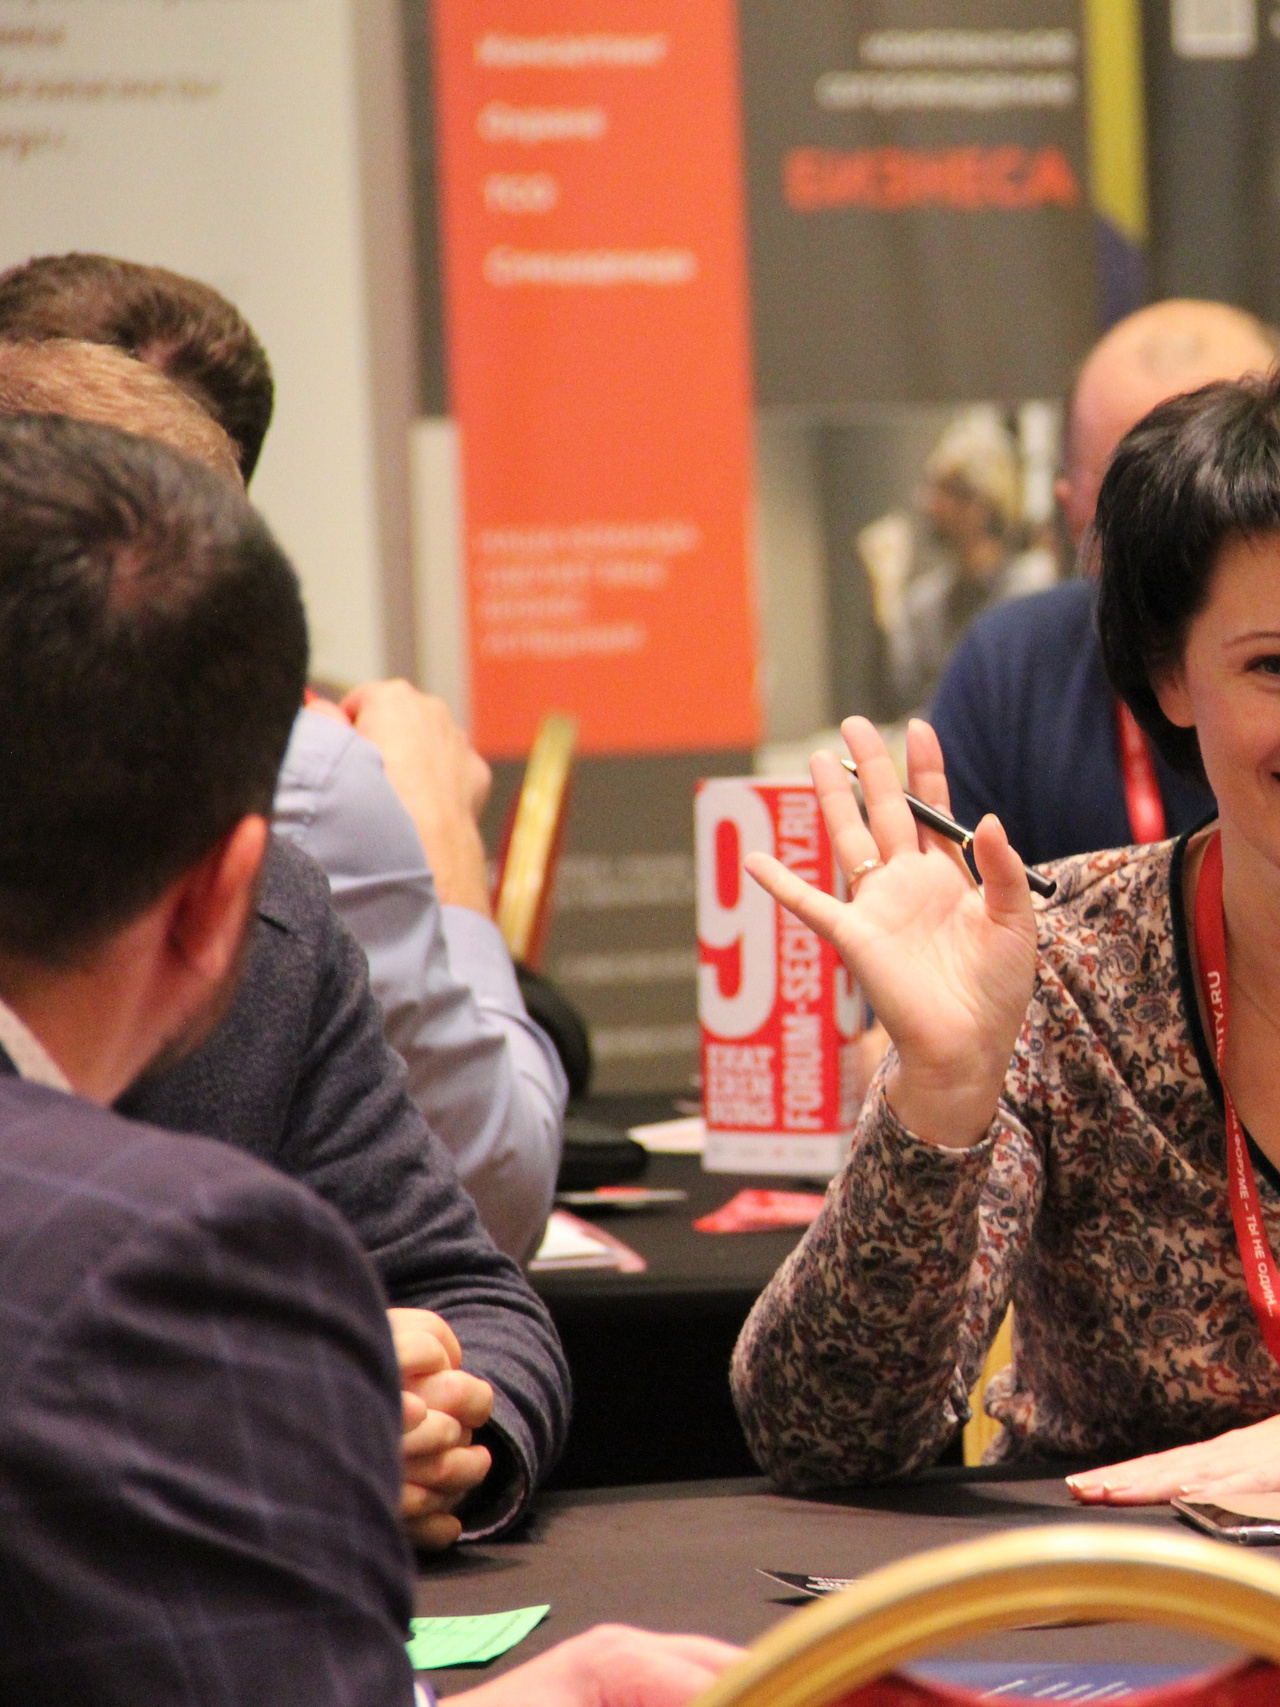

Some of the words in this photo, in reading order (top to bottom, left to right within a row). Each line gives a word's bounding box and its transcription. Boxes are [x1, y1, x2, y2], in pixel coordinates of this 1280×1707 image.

[783, 147, 1077, 212] БИЗНЕСА
[697, 783, 777, 1039] 9
[1246, 1214, 1259, 1236] ТЫ
[1252, 1238, 1266, 1259] НЕ
